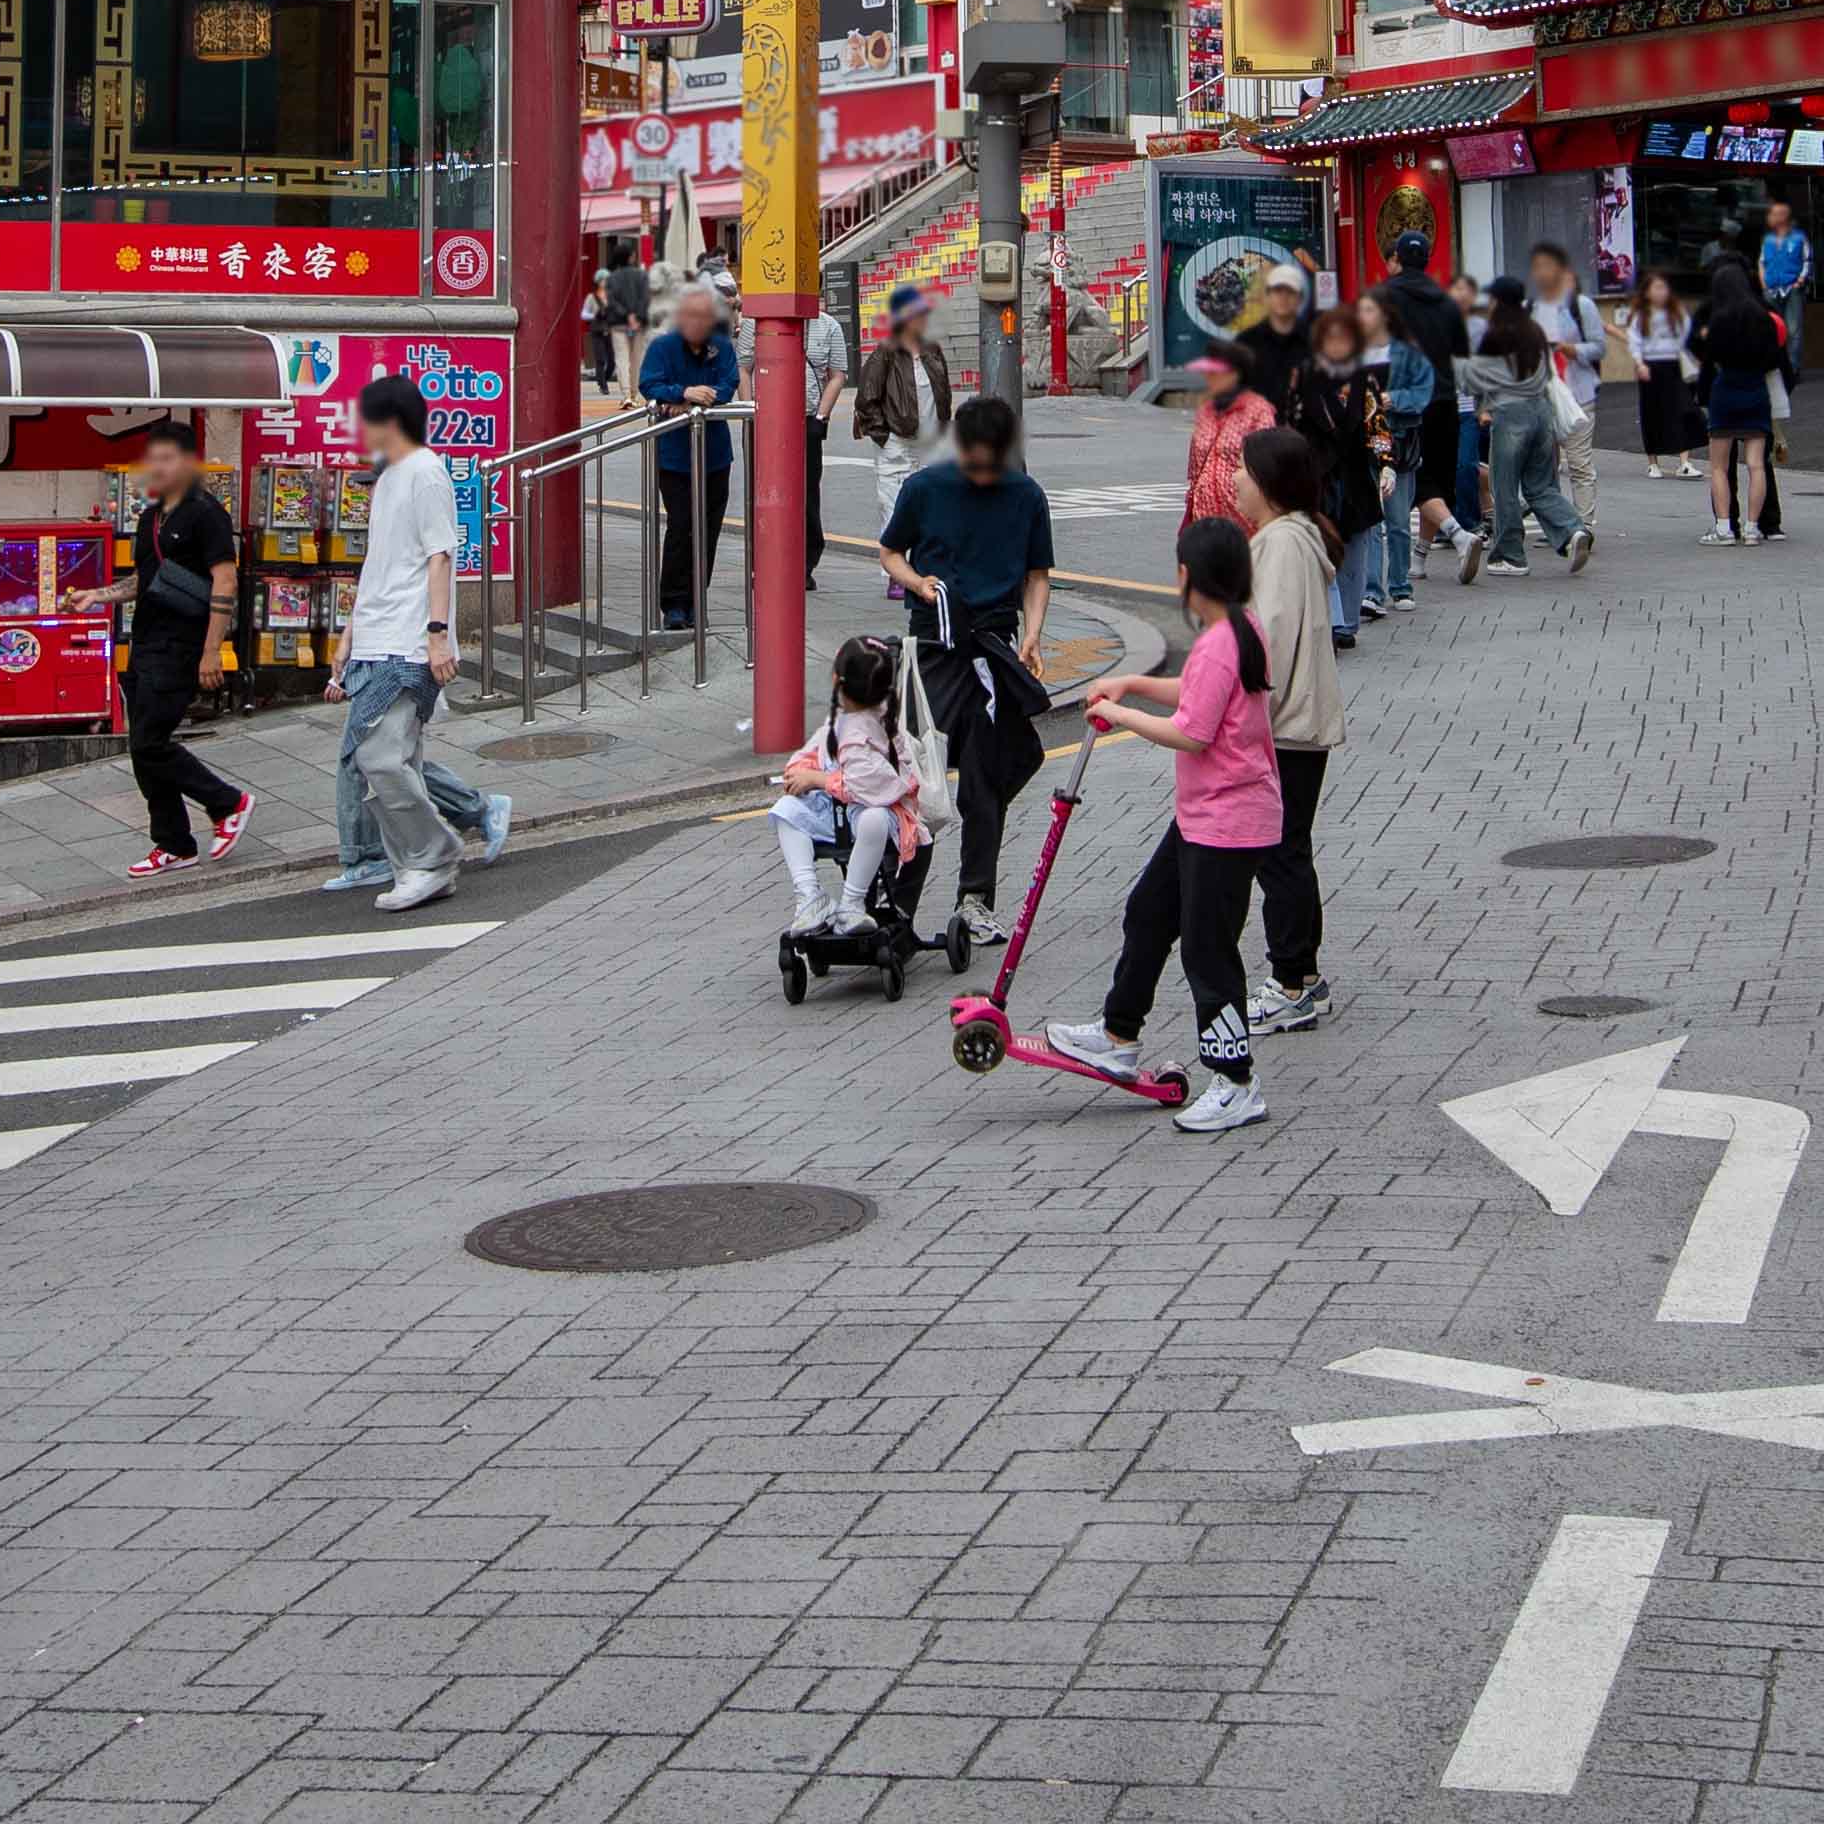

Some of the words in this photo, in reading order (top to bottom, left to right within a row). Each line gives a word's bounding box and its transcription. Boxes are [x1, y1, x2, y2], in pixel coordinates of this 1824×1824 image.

[640, 126, 666, 145] 30
[150, 247, 208, 263] 中華料理
[407, 344, 450, 370] 나눔
